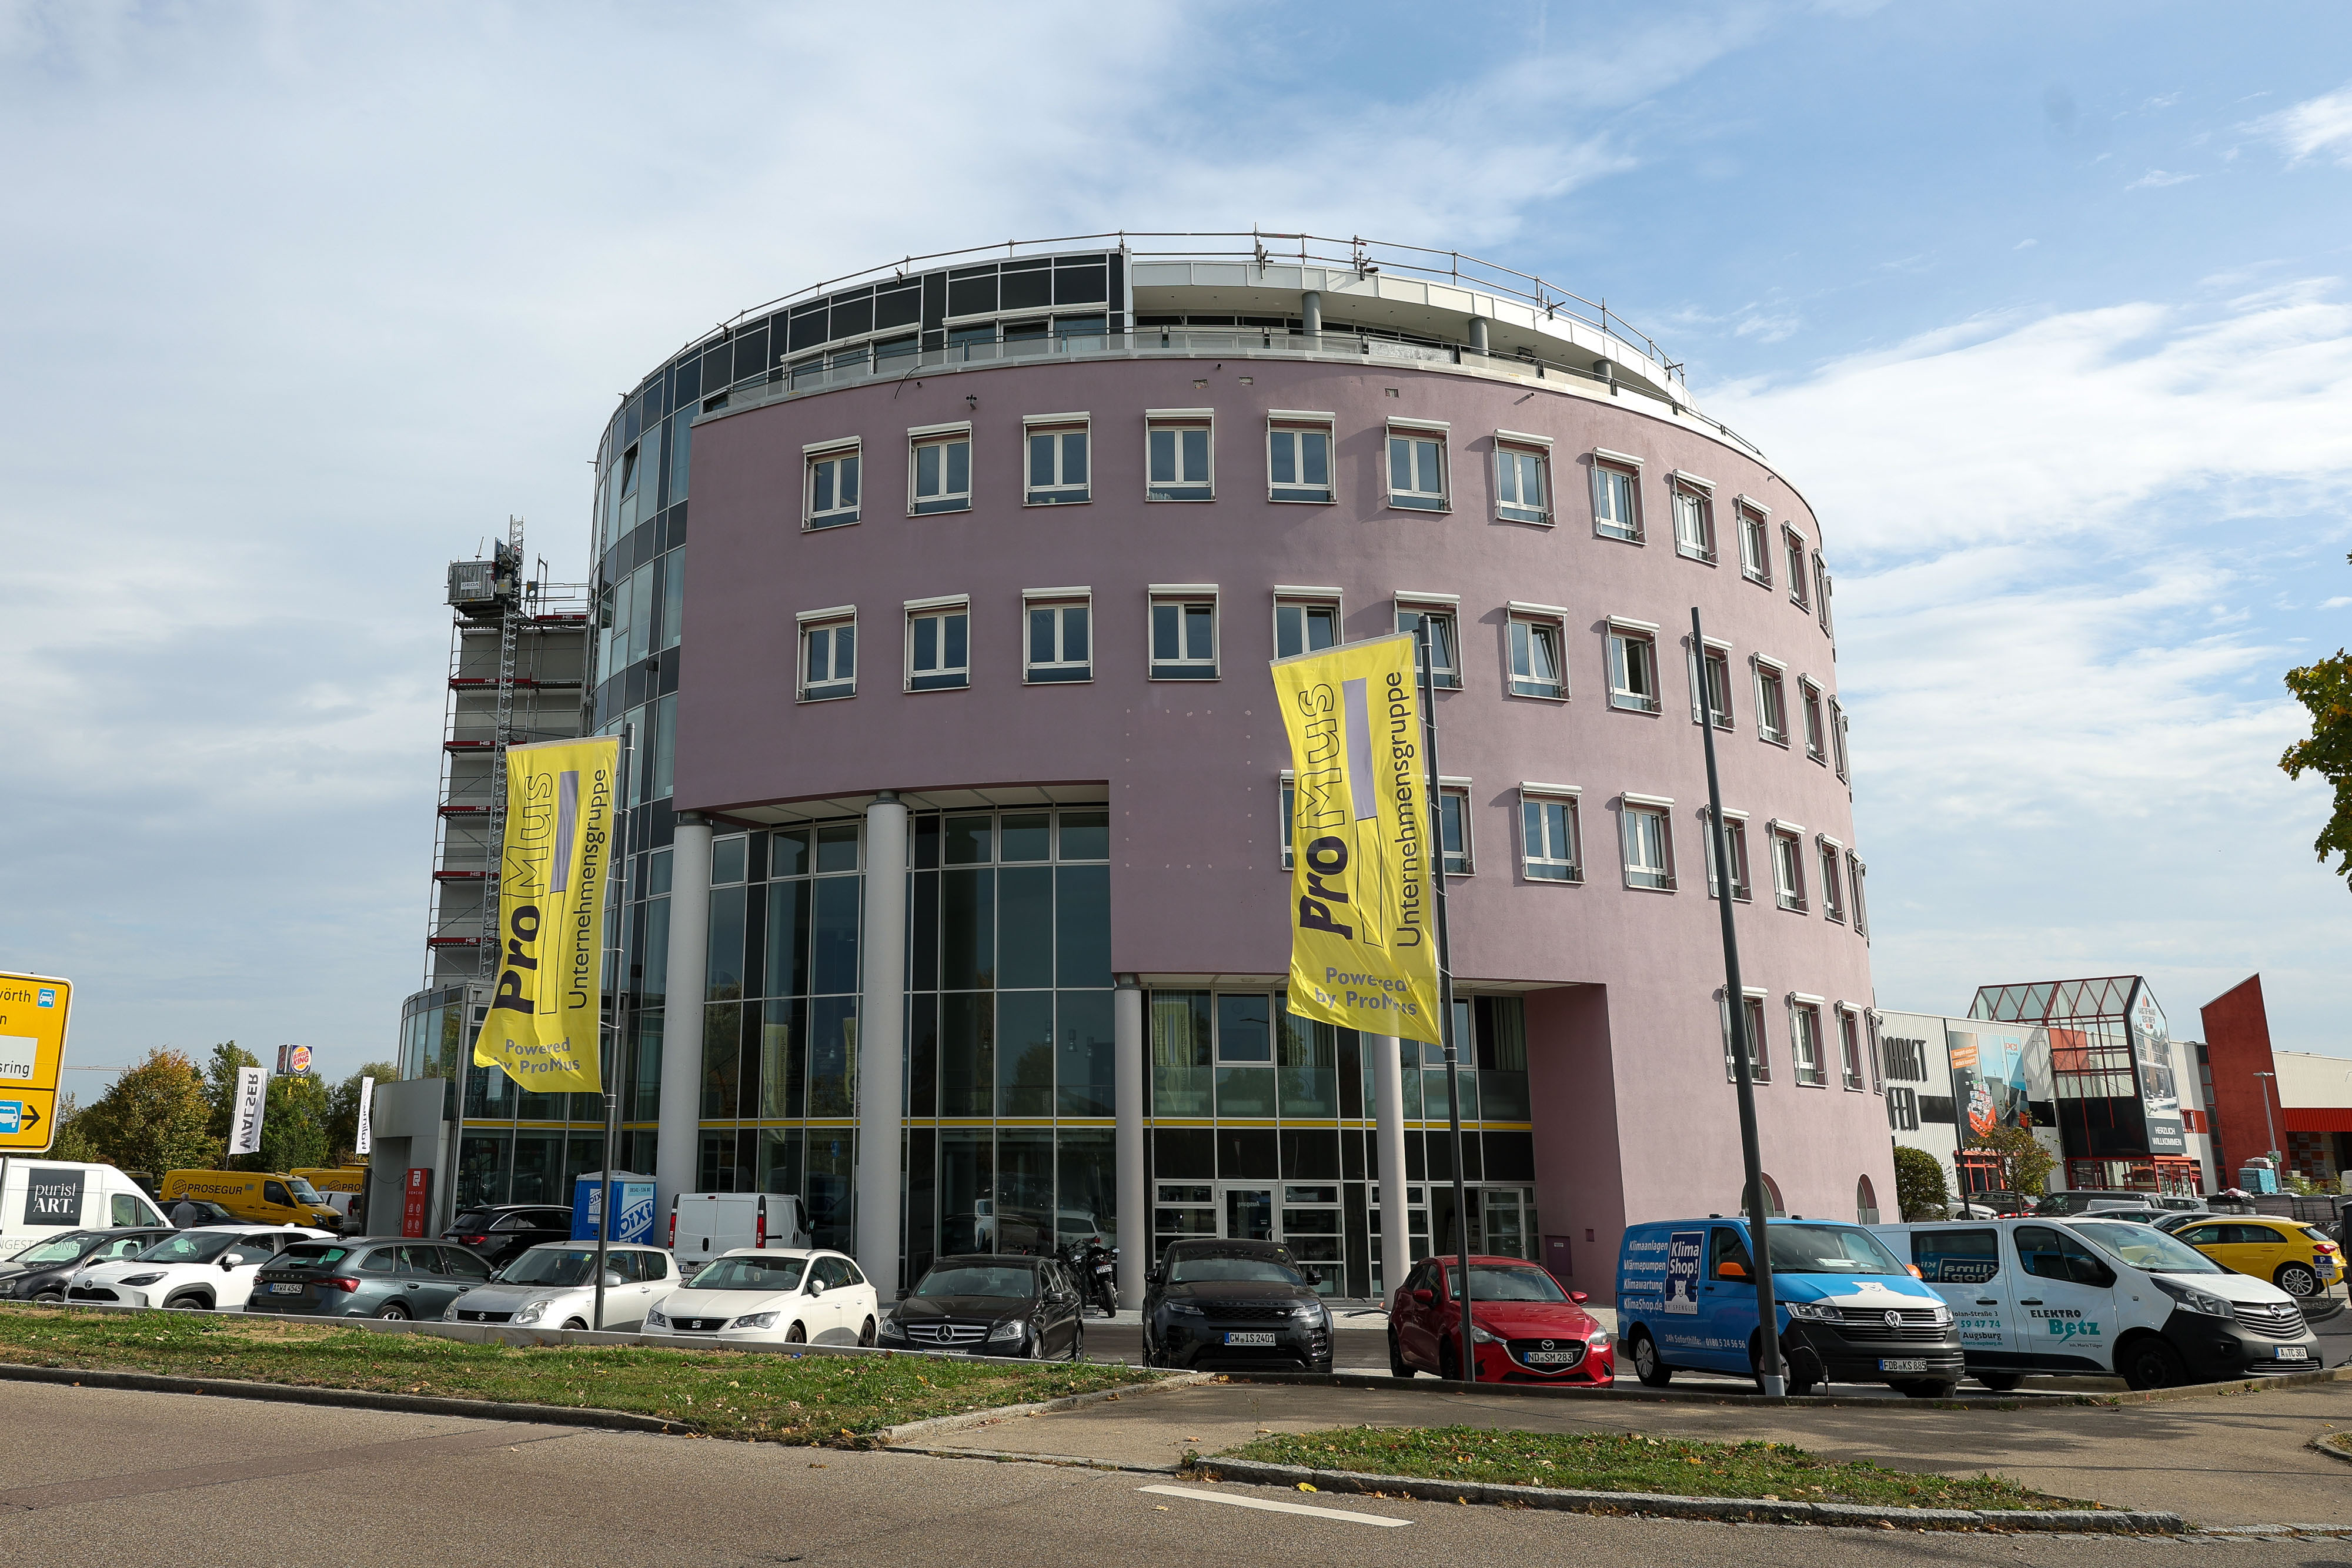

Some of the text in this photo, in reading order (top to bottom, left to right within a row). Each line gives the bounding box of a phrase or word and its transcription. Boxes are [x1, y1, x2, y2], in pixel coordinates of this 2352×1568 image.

[1297, 683, 1353, 941] ProMus
[1385, 671, 1422, 947] Unternehmensgruppe
[492, 771, 553, 1015] ProMus
[568, 768, 606, 1009] Unternehmensgruppe
[1325, 967, 1407, 992] Powered
[0, 988, 31, 1003] örth
[1315, 988, 1418, 1016] by ProMus
[505, 1037, 572, 1056] Powered
[2005, 1042, 2018, 1051] PCI
[293, 1051, 309, 1059] BURGER
[293, 1056, 309, 1067] KING
[520, 1057, 580, 1075] ProMus
[2154, 1126, 2176, 1135] HERZLICH
[2151, 1137, 2182, 1146] WILLKOMMEN
[34, 1182, 76, 1201] purist
[187, 1184, 243, 1195] PROSEGUR
[589, 1192, 602, 1204] DIX
[32, 1198, 74, 1213] ART.
[1629, 1240, 1668, 1253] Klimaanlagen
[1671, 1241, 1699, 1256] Klima
[1624, 1259, 1666, 1273] Wärmepumpen
[1670, 1258, 1698, 1278] Shop!
[272, 1283, 302, 1293] A WA 4545
[1624, 1278, 1663, 1293] Klimawartung
[1624, 1298, 1663, 1313] KlimaShop.de
[2030, 1309, 2082, 1318] ELEKTRO
[2048, 1319, 2100, 1338] Betz
[1230, 1334, 1275, 1343] CW IS 2401
[1665, 1334, 1675, 1342] 24h
[1674, 1335, 1702, 1345] Soforthilfe:
[1706, 1338, 1718, 1346] 0180
[1963, 1332, 2002, 1340] Augsburg
[1529, 1353, 1572, 1362] ND SM 283
[2281, 1349, 2305, 1357] A TC 383
[1883, 1361, 1926, 1370] FDB KS 885
